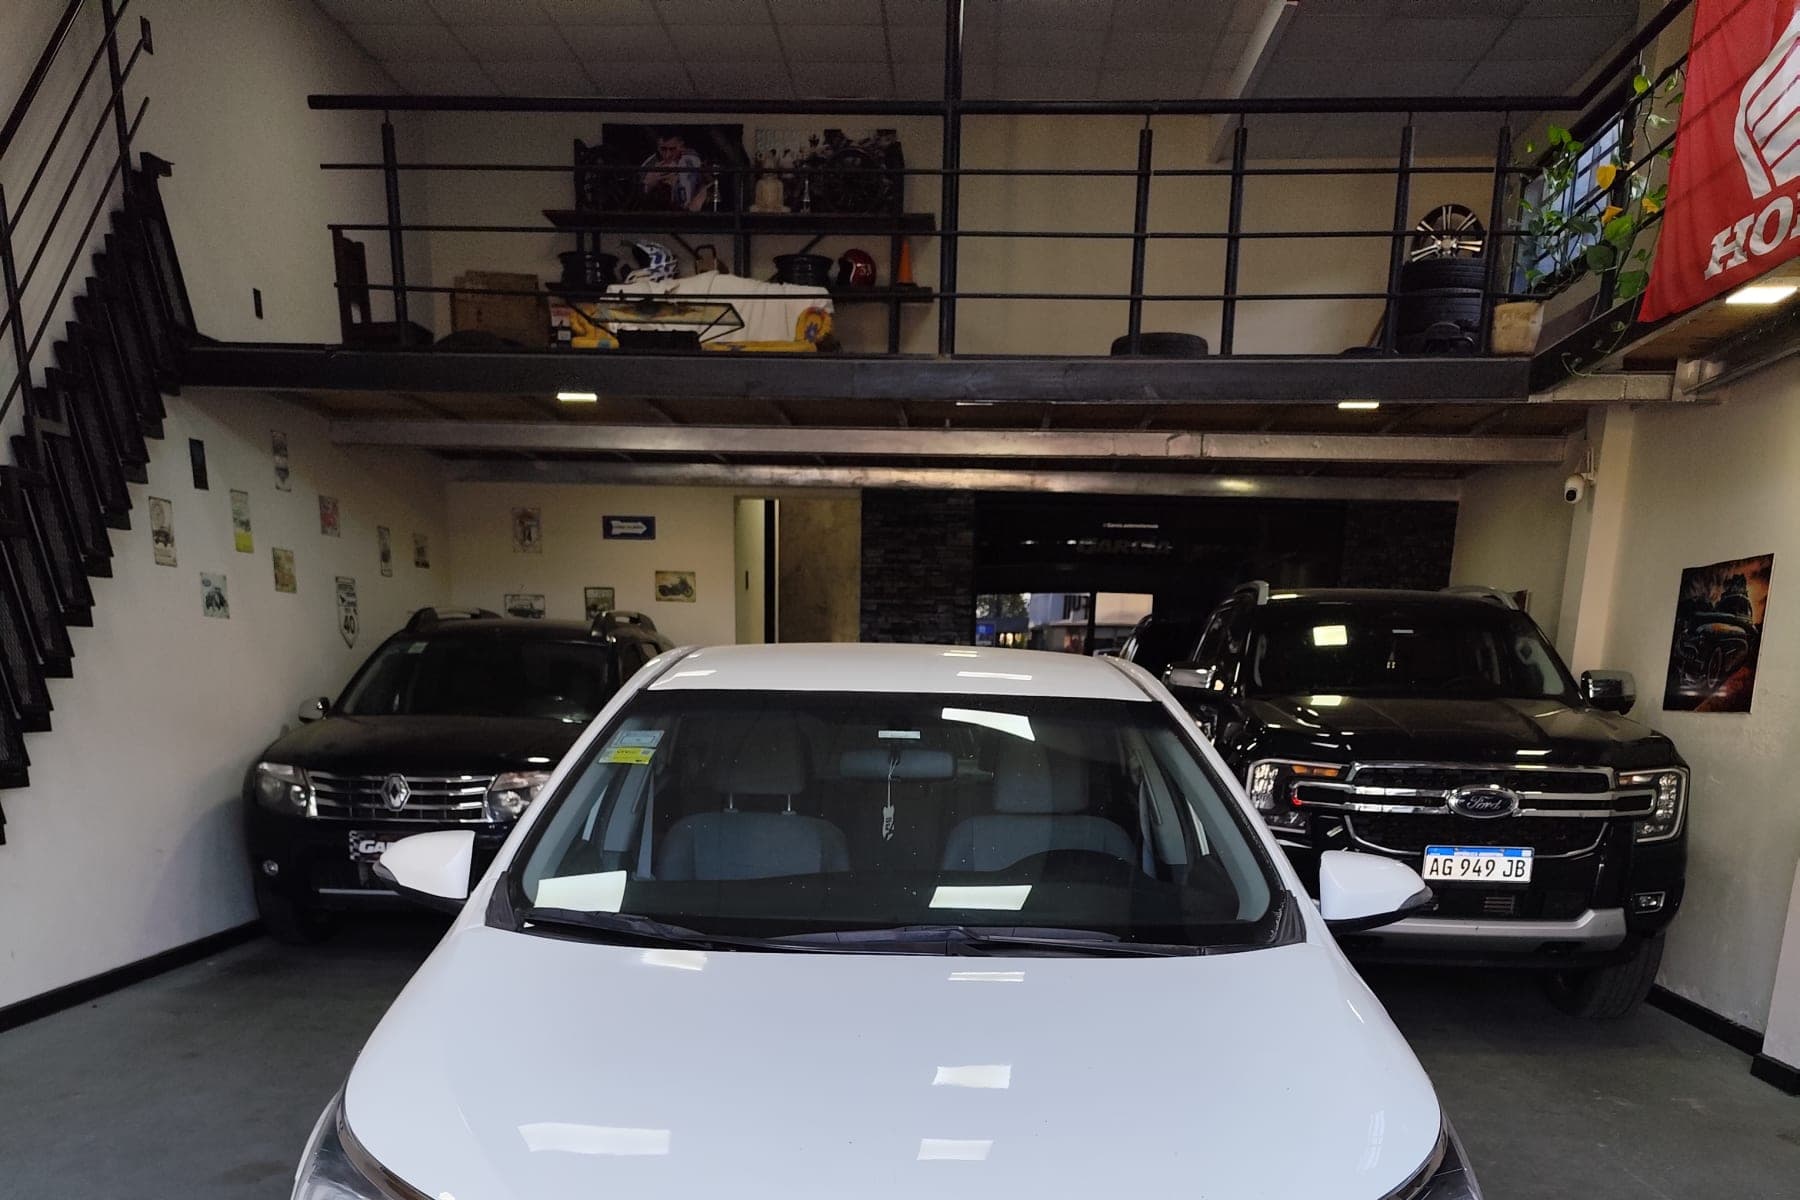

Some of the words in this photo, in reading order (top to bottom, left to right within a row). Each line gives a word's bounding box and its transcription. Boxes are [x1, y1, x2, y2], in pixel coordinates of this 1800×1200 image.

[1704, 192, 1800, 280] HO
[1466, 796, 1502, 810] Ford
[1430, 858, 1453, 876] AG
[1460, 858, 1495, 877] 949
[1503, 860, 1525, 877] JB
